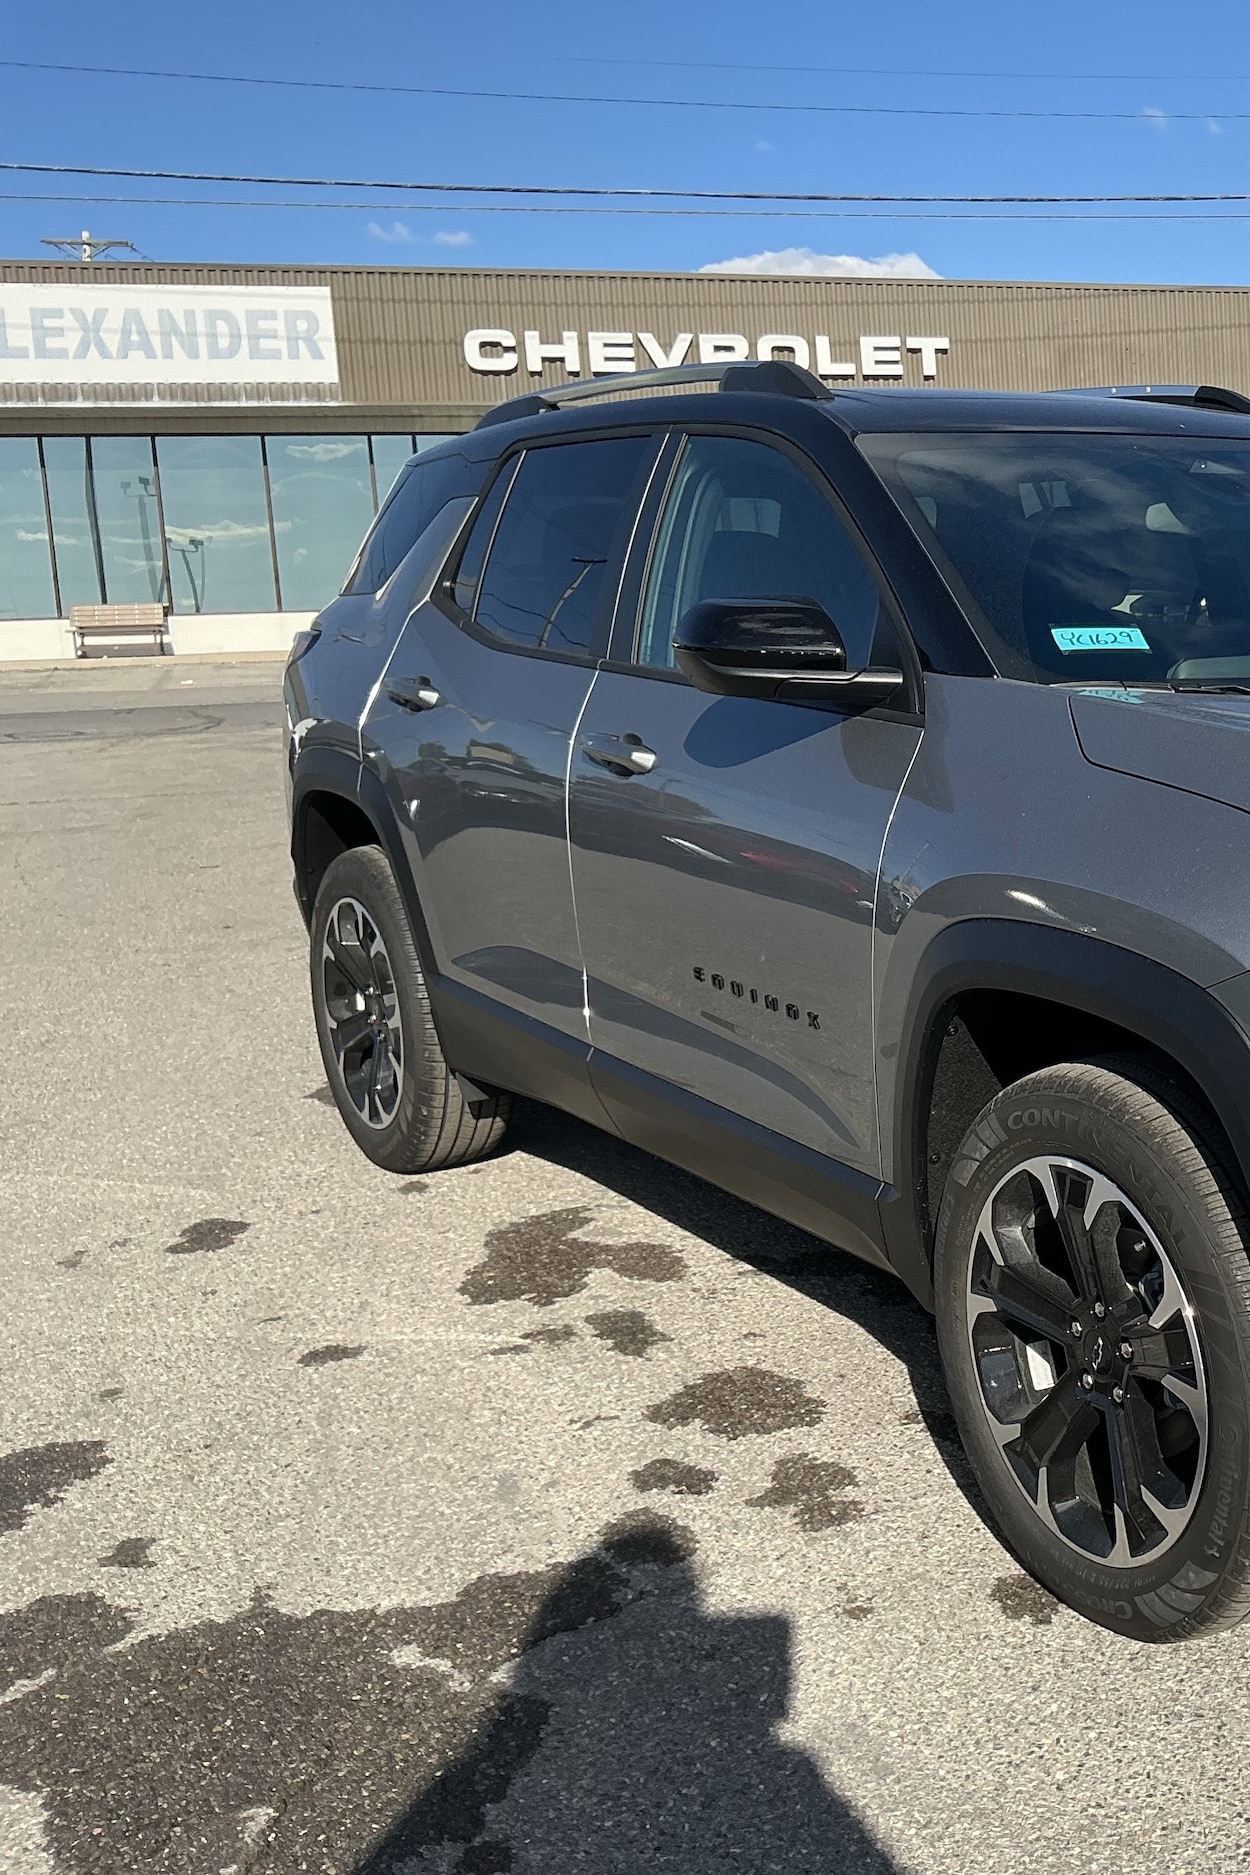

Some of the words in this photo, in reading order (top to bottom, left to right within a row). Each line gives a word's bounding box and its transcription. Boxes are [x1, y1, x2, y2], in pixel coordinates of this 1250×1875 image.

[0, 307, 326, 360] LEXANDER
[463, 328, 950, 376] CHEVROLET
[1060, 630, 1134, 646] YC1629
[693, 966, 821, 1031] EQUINOX
